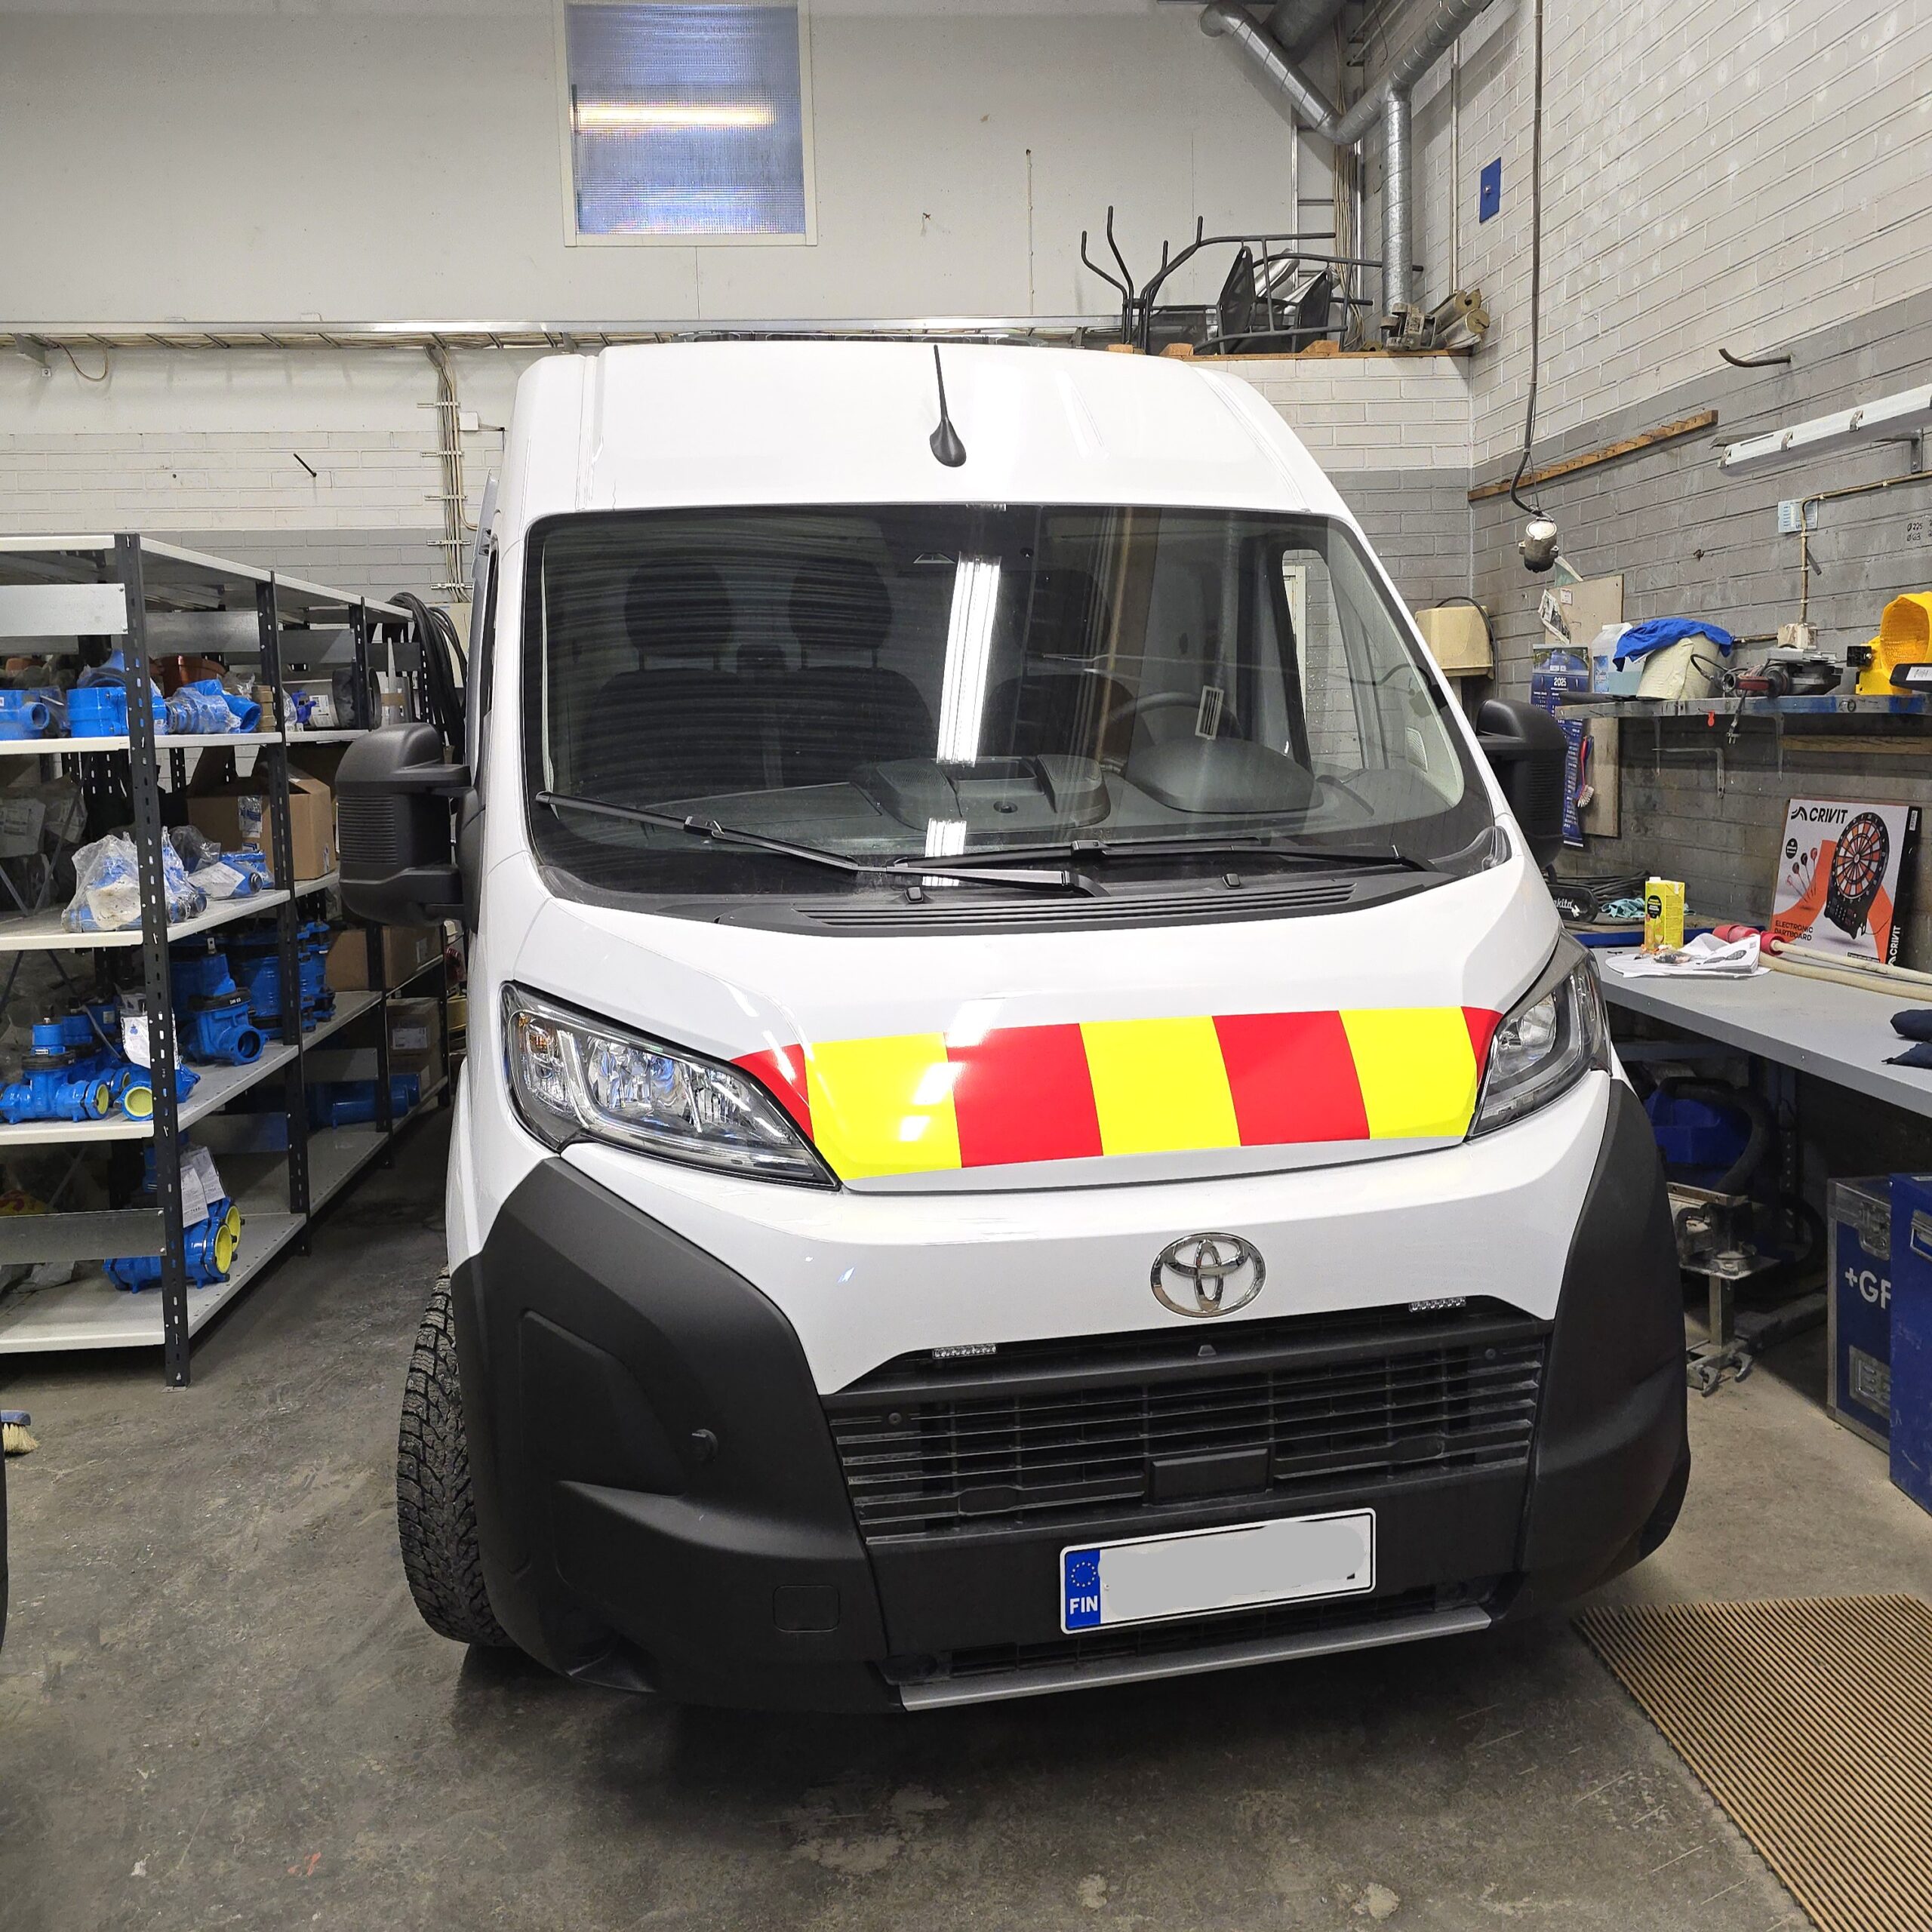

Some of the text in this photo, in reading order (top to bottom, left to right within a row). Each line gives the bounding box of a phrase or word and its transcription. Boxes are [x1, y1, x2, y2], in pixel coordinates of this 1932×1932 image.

[1554, 677, 1567, 687] 2025
[1809, 807, 1848, 824] CRIVIT
[1552, 897, 1574, 909] akita
[1775, 920, 1814, 934] ELECTRONIC
[1774, 928, 1812, 941] DARTBOARD
[1889, 925, 1901, 955] CRIVIT
[1069, 1595, 1098, 1615] FIN
